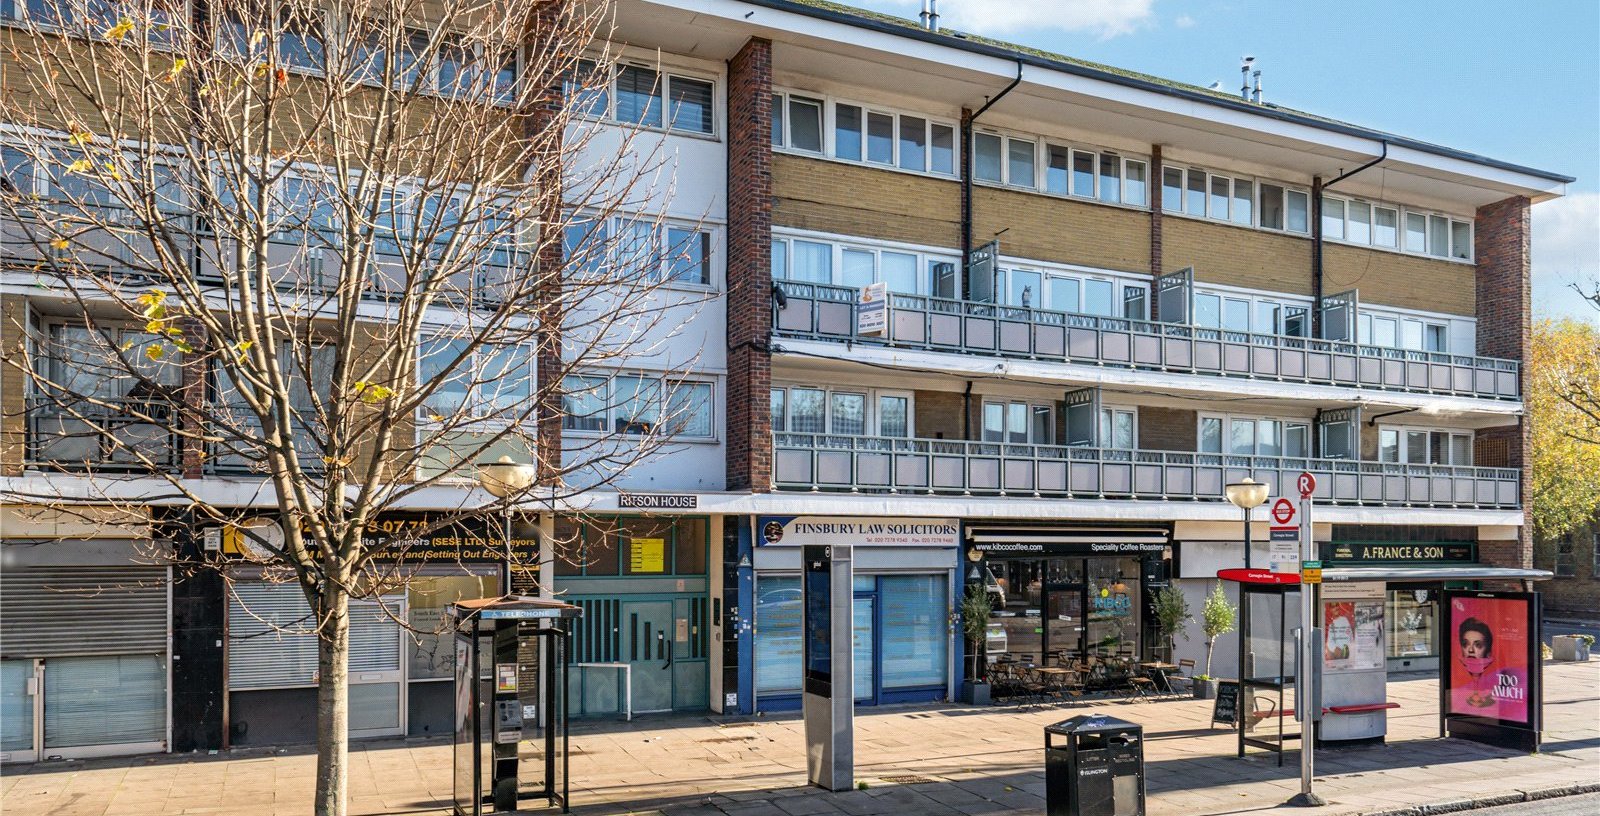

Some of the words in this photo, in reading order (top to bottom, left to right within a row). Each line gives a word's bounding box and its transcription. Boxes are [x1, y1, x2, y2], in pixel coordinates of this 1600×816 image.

[1301, 476, 1310, 492] R
[661, 496, 696, 507] HOUSE
[795, 523, 855, 534] FINSBURY
[859, 524, 886, 534] LAW
[887, 524, 957, 535] SOLICITORS
[432, 538, 462, 547] (SESE
[489, 537, 536, 547] Sureyors
[975, 543, 1043, 551] www.kibcocoffee.com
[1091, 543, 1119, 552] Speciality
[1120, 543, 1139, 551] Coffee
[1139, 543, 1164, 551] Roasters
[406, 550, 425, 558] and
[426, 550, 460, 560] Setting
[463, 550, 480, 558] Out
[1363, 546, 1411, 559] A.FRANCE
[1413, 546, 1423, 559] &
[1424, 546, 1444, 559] SON
[500, 609, 549, 617] TELEPHONE
[1496, 674, 1518, 687] TOO
[1492, 685, 1523, 699] MUCH
